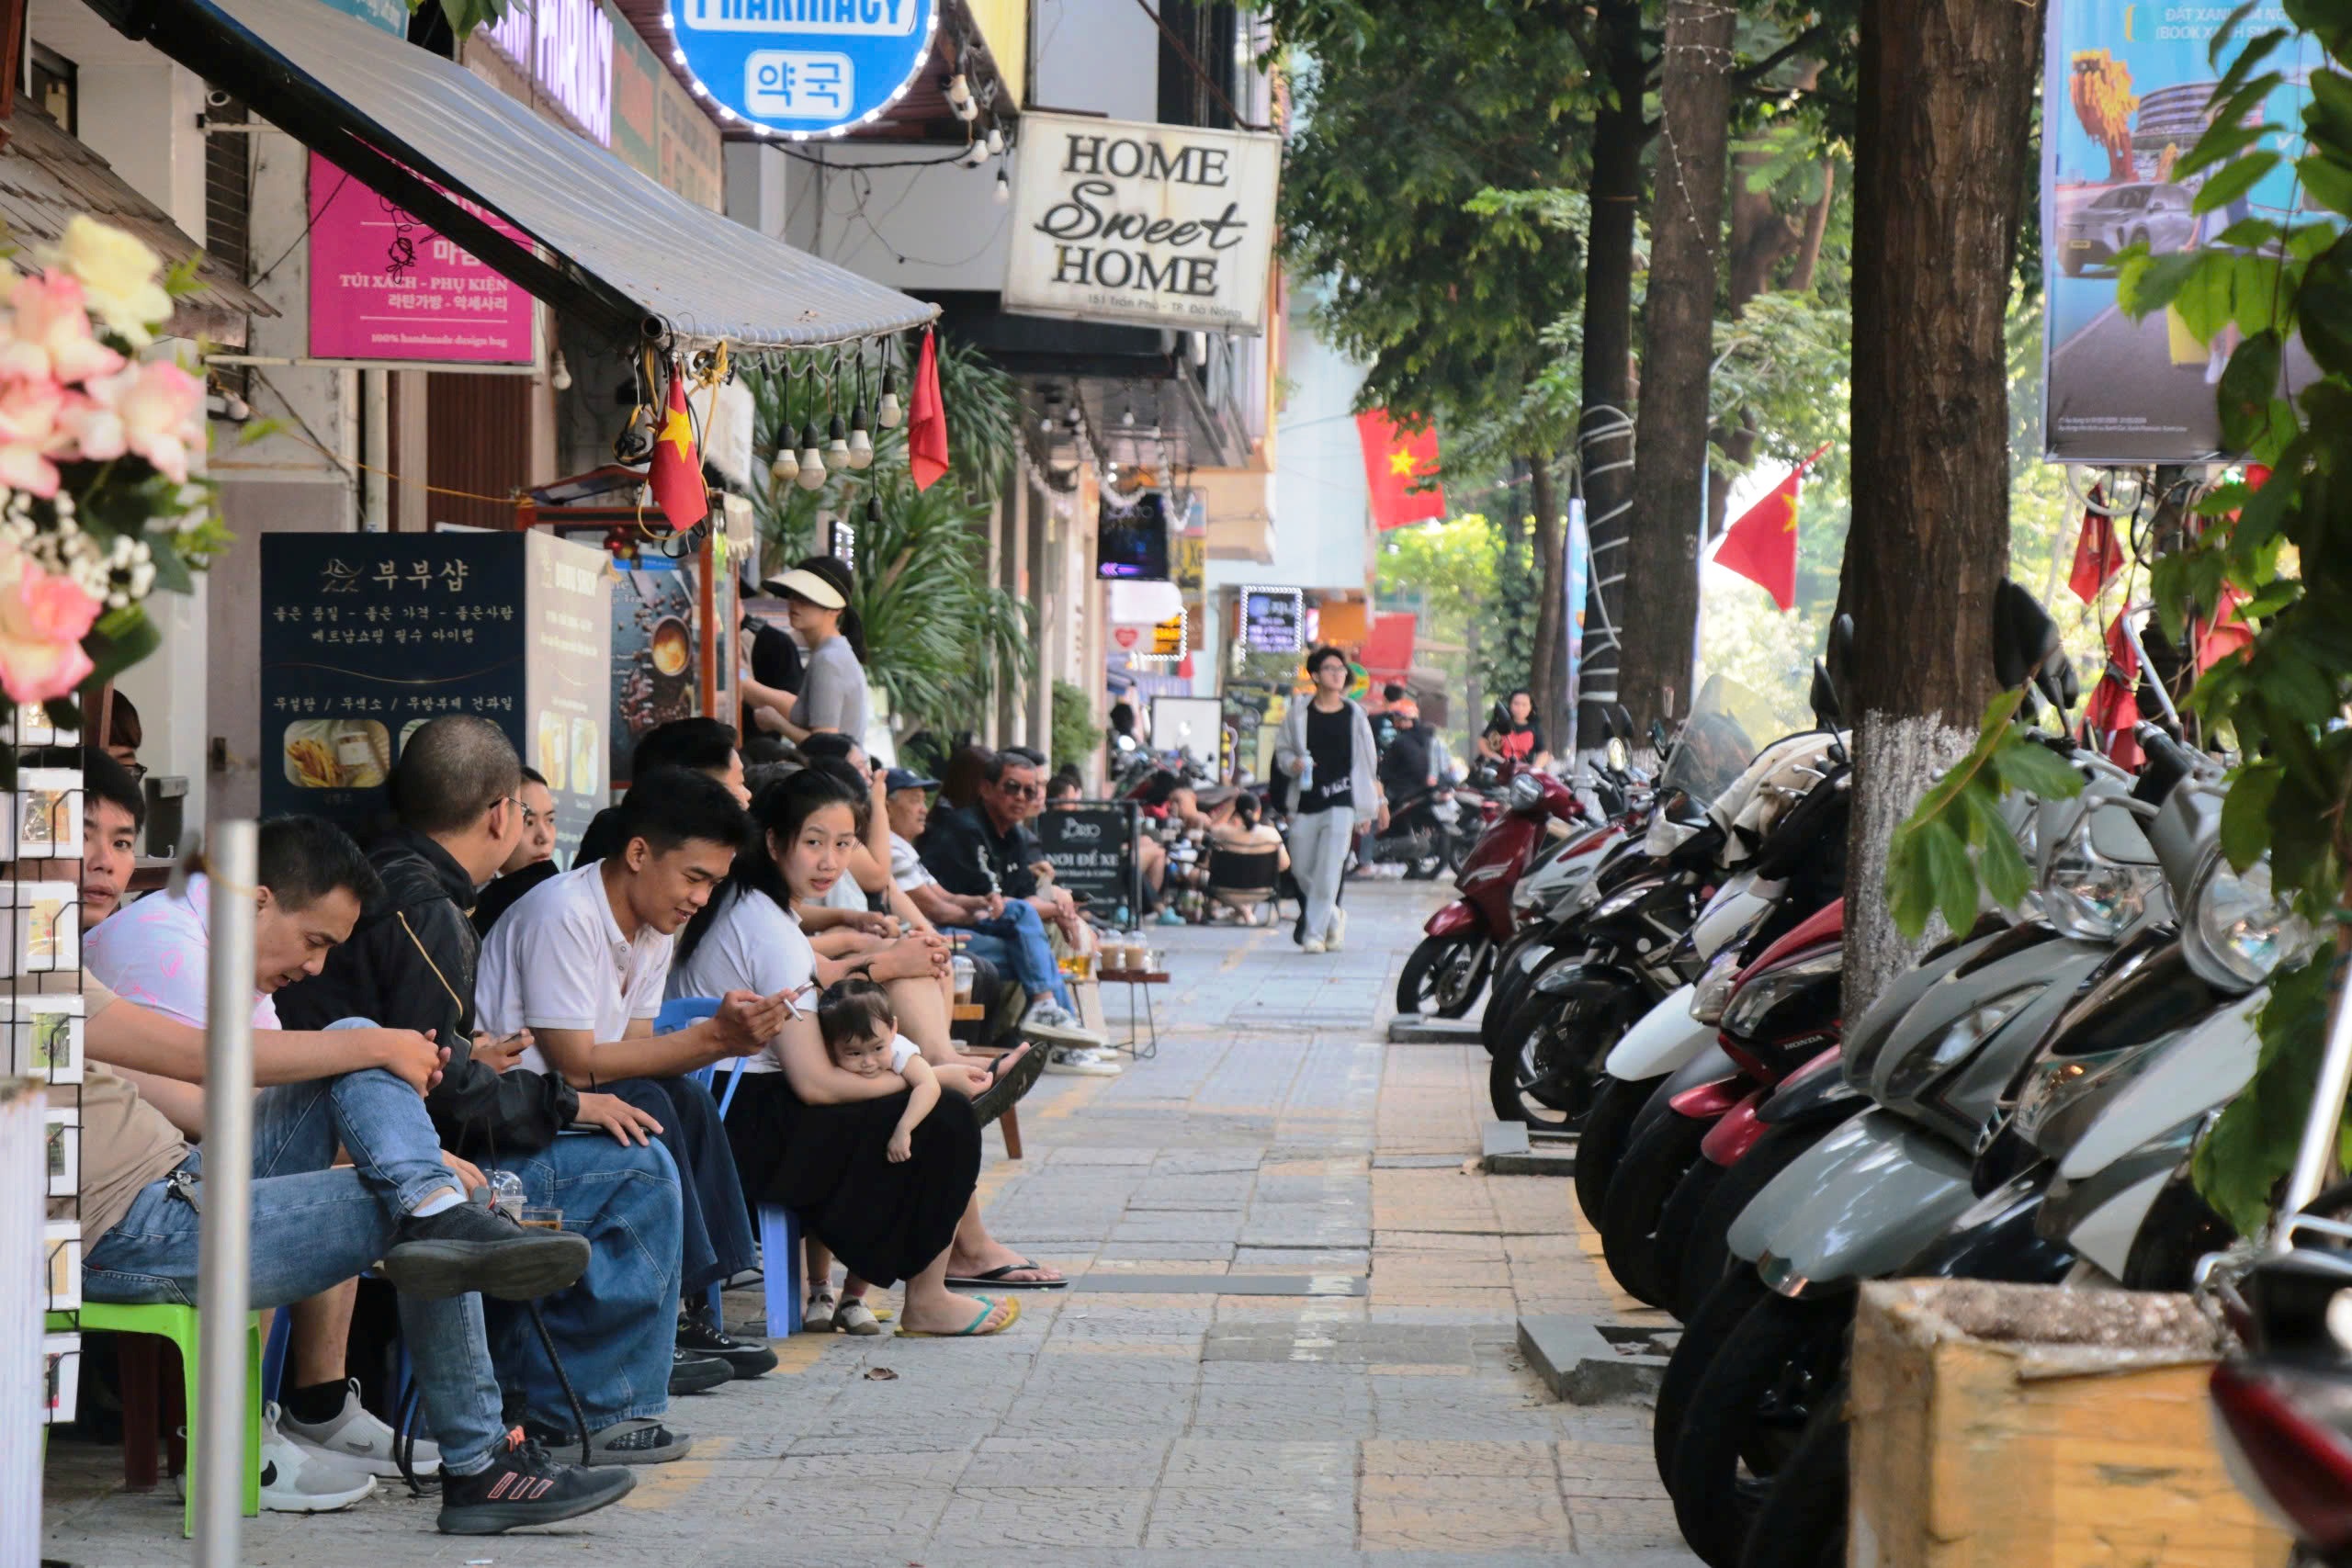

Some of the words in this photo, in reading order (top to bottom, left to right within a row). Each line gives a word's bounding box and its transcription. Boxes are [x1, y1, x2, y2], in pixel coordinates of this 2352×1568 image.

[757, 62, 842, 108] 약국
[1062, 133, 1229, 187] HOME
[1033, 180, 1249, 250] Sweet
[1051, 243, 1219, 297] HOME
[1783, 1034, 1824, 1051] HONDA
